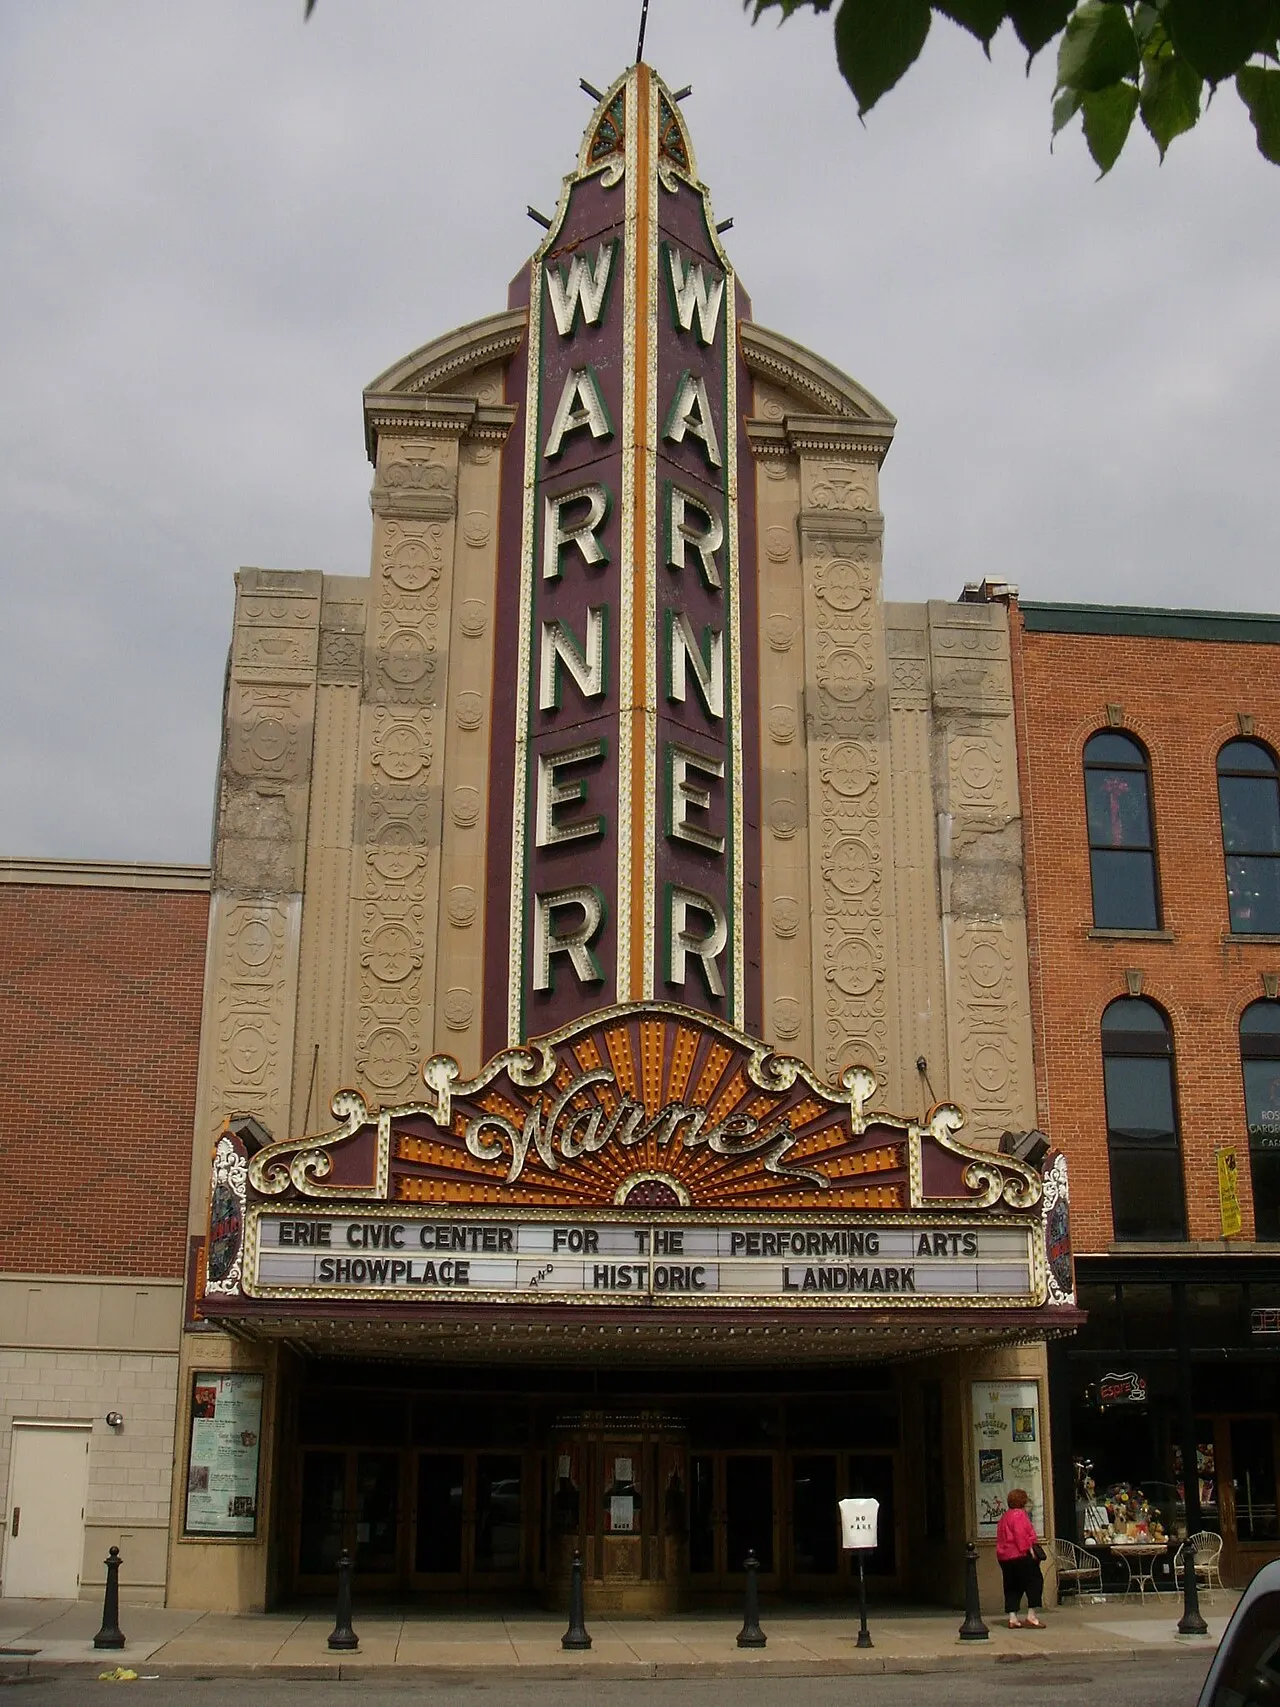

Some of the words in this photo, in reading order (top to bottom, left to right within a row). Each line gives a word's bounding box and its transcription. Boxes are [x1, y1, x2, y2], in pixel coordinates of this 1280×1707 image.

[533, 237, 619, 991] WARNER
[662, 240, 728, 998] WARNER
[465, 1067, 832, 1189] Warner
[279, 1221, 332, 1246] ERIE
[346, 1223, 405, 1249] CIVIC
[419, 1225, 513, 1252] CENTER
[552, 1228, 599, 1254] FOR
[634, 1230, 684, 1256] THE
[730, 1231, 880, 1256] PERFORMING
[916, 1232, 977, 1256] ARTS
[319, 1257, 470, 1286] SHOWPLACE
[528, 1263, 554, 1288] AND
[592, 1264, 706, 1291] HISTORIC
[782, 1266, 916, 1293] LANDMARK
[1251, 1310, 1280, 1331] OP
